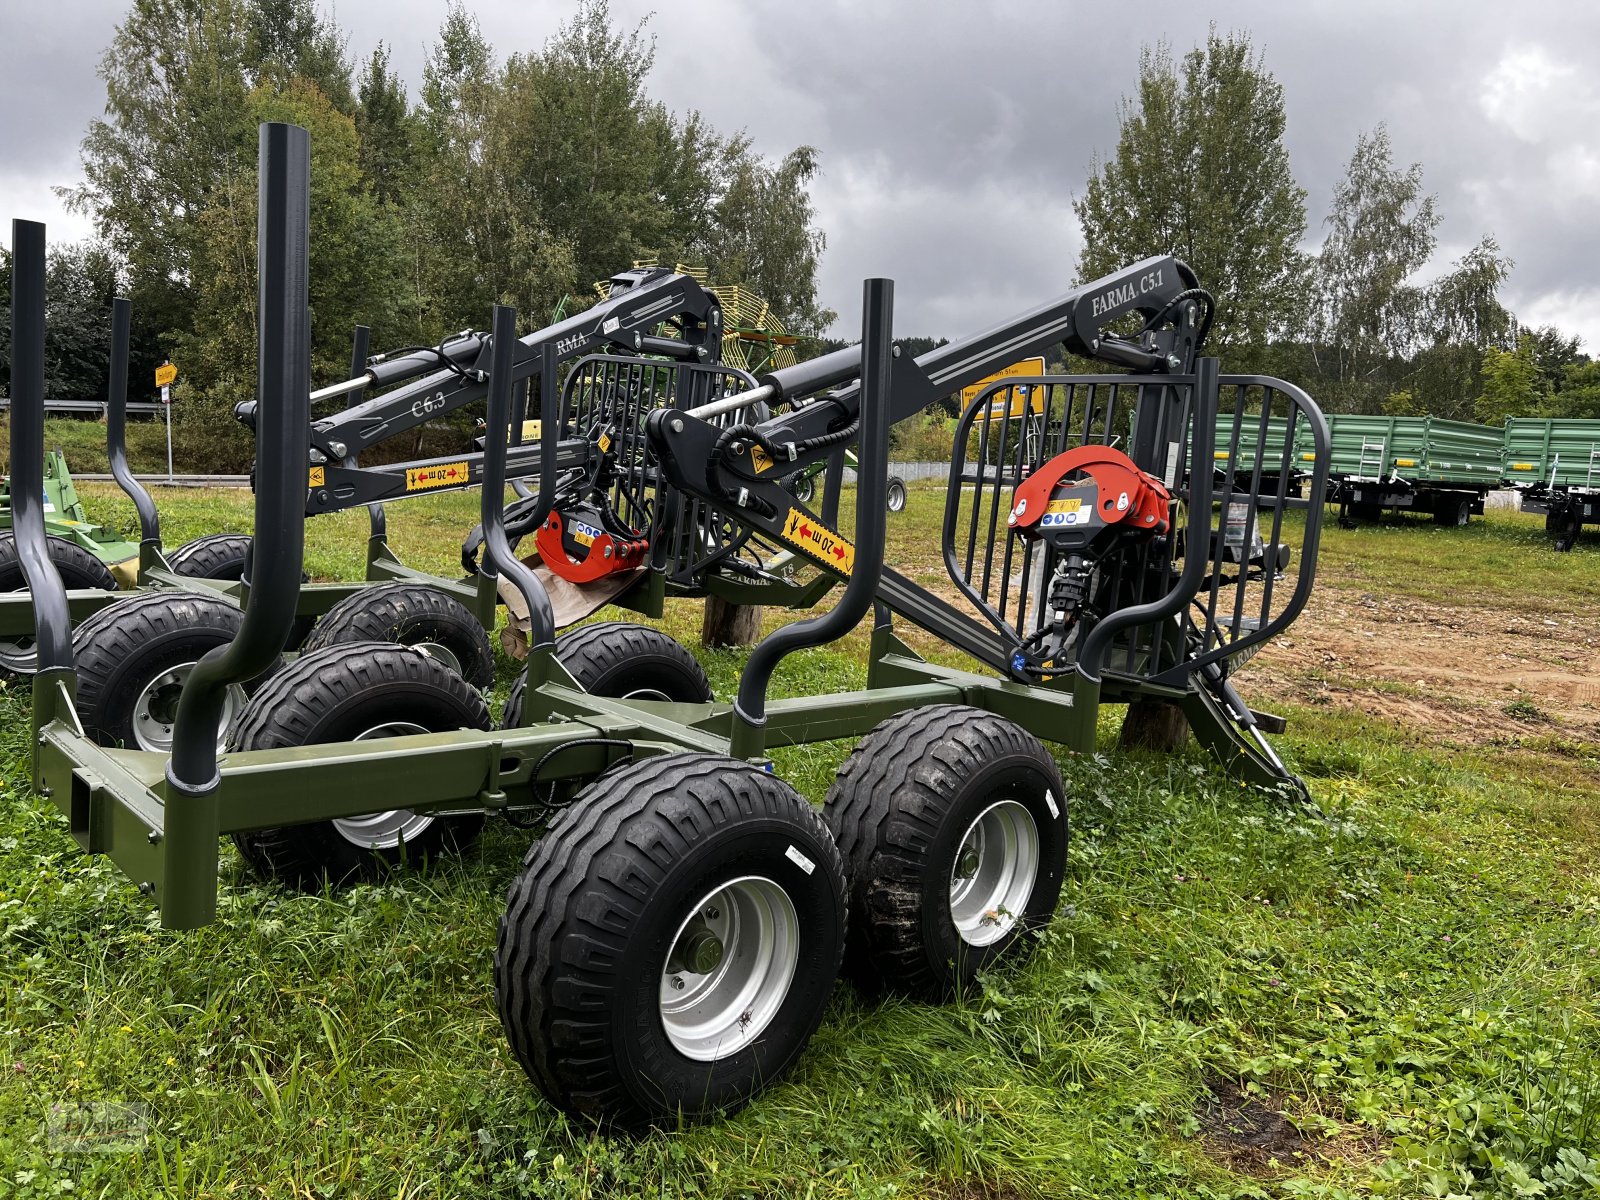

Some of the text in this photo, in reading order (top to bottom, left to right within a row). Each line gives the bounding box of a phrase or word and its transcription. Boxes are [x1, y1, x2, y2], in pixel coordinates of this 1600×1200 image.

[1091, 269, 1164, 317] FARMA C5.1
[556, 331, 588, 356] RMA
[411, 391, 446, 418] C6.3
[522, 432, 539, 440] ONE
[428, 470, 447, 480] 20 m
[811, 530, 835, 555] 20 m
